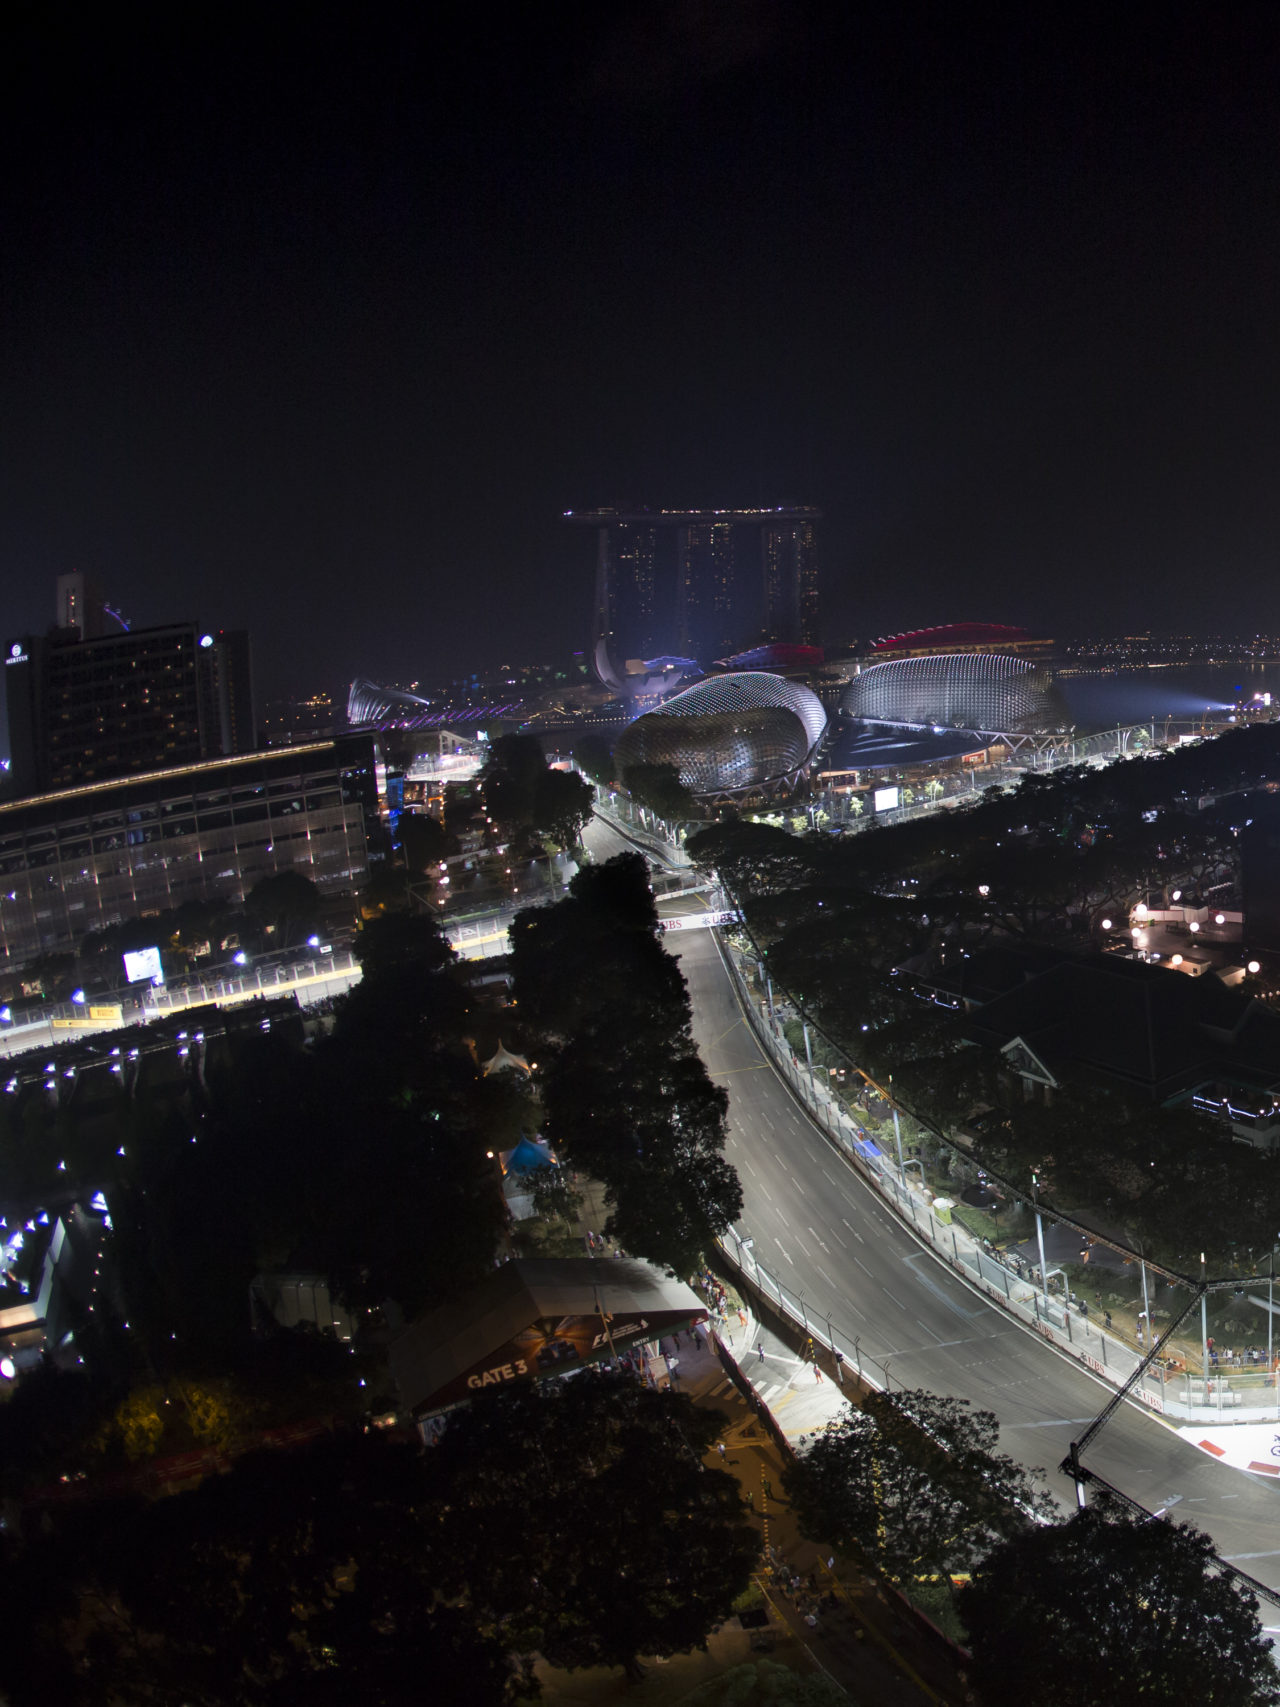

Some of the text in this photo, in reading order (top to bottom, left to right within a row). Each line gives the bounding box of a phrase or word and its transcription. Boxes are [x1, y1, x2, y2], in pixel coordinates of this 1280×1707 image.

[1037, 1322, 1055, 1340] UBS
[632, 1337, 650, 1347] ENTRY
[467, 1359, 528, 1389] GATE 3
[1087, 1356, 1106, 1374] UBS
[1143, 1391, 1163, 1411] UBS
